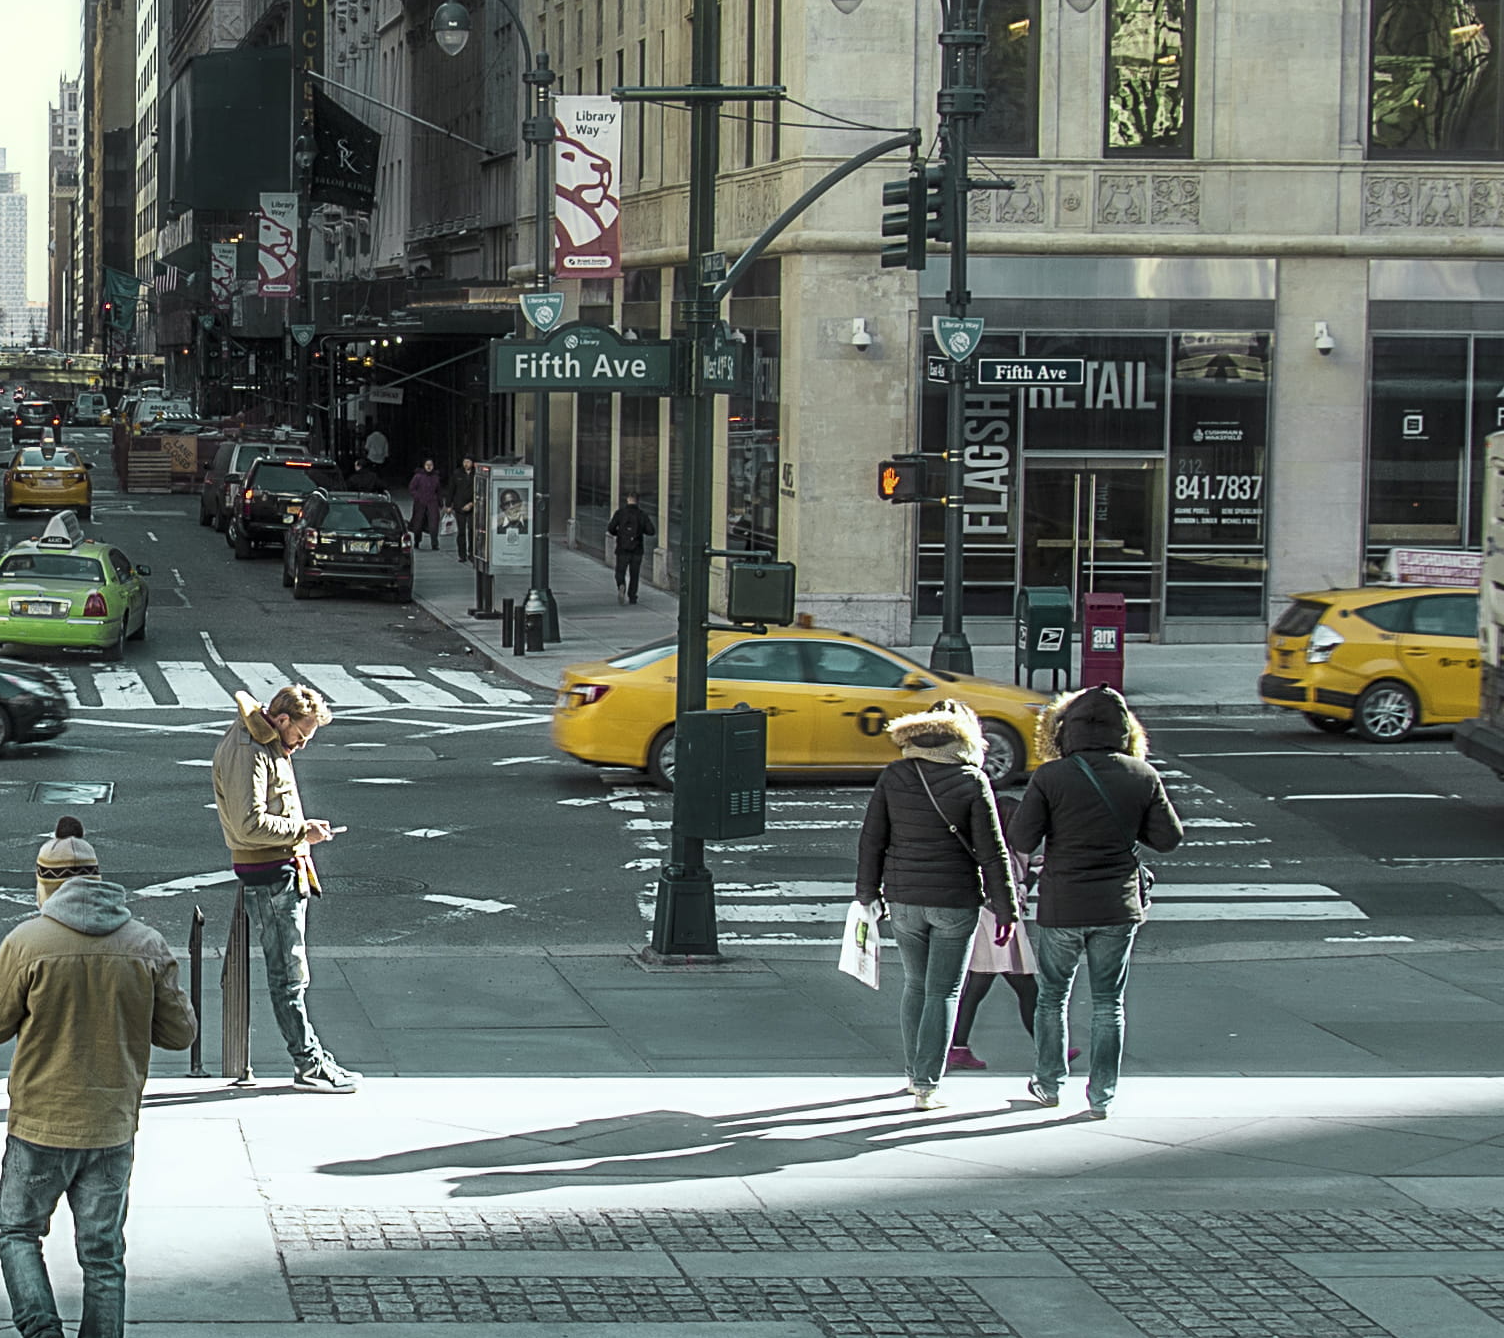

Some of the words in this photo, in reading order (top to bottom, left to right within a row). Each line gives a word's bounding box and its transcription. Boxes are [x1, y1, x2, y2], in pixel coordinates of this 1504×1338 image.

[576, 111, 616, 124] Library
[576, 124, 599, 137] Way
[271, 201, 295, 210] Library
[941, 321, 963, 329] Library
[965, 322, 979, 330] Way
[515, 351, 580, 379] Fifth
[593, 353, 647, 379] Ave
[995, 364, 1033, 380] Fifth
[1037, 365, 1067, 380] Ave
[163, 442, 191, 469] CLOSED
[173, 439, 193, 459] LANE
[1175, 475, 1263, 500] 841.7837
